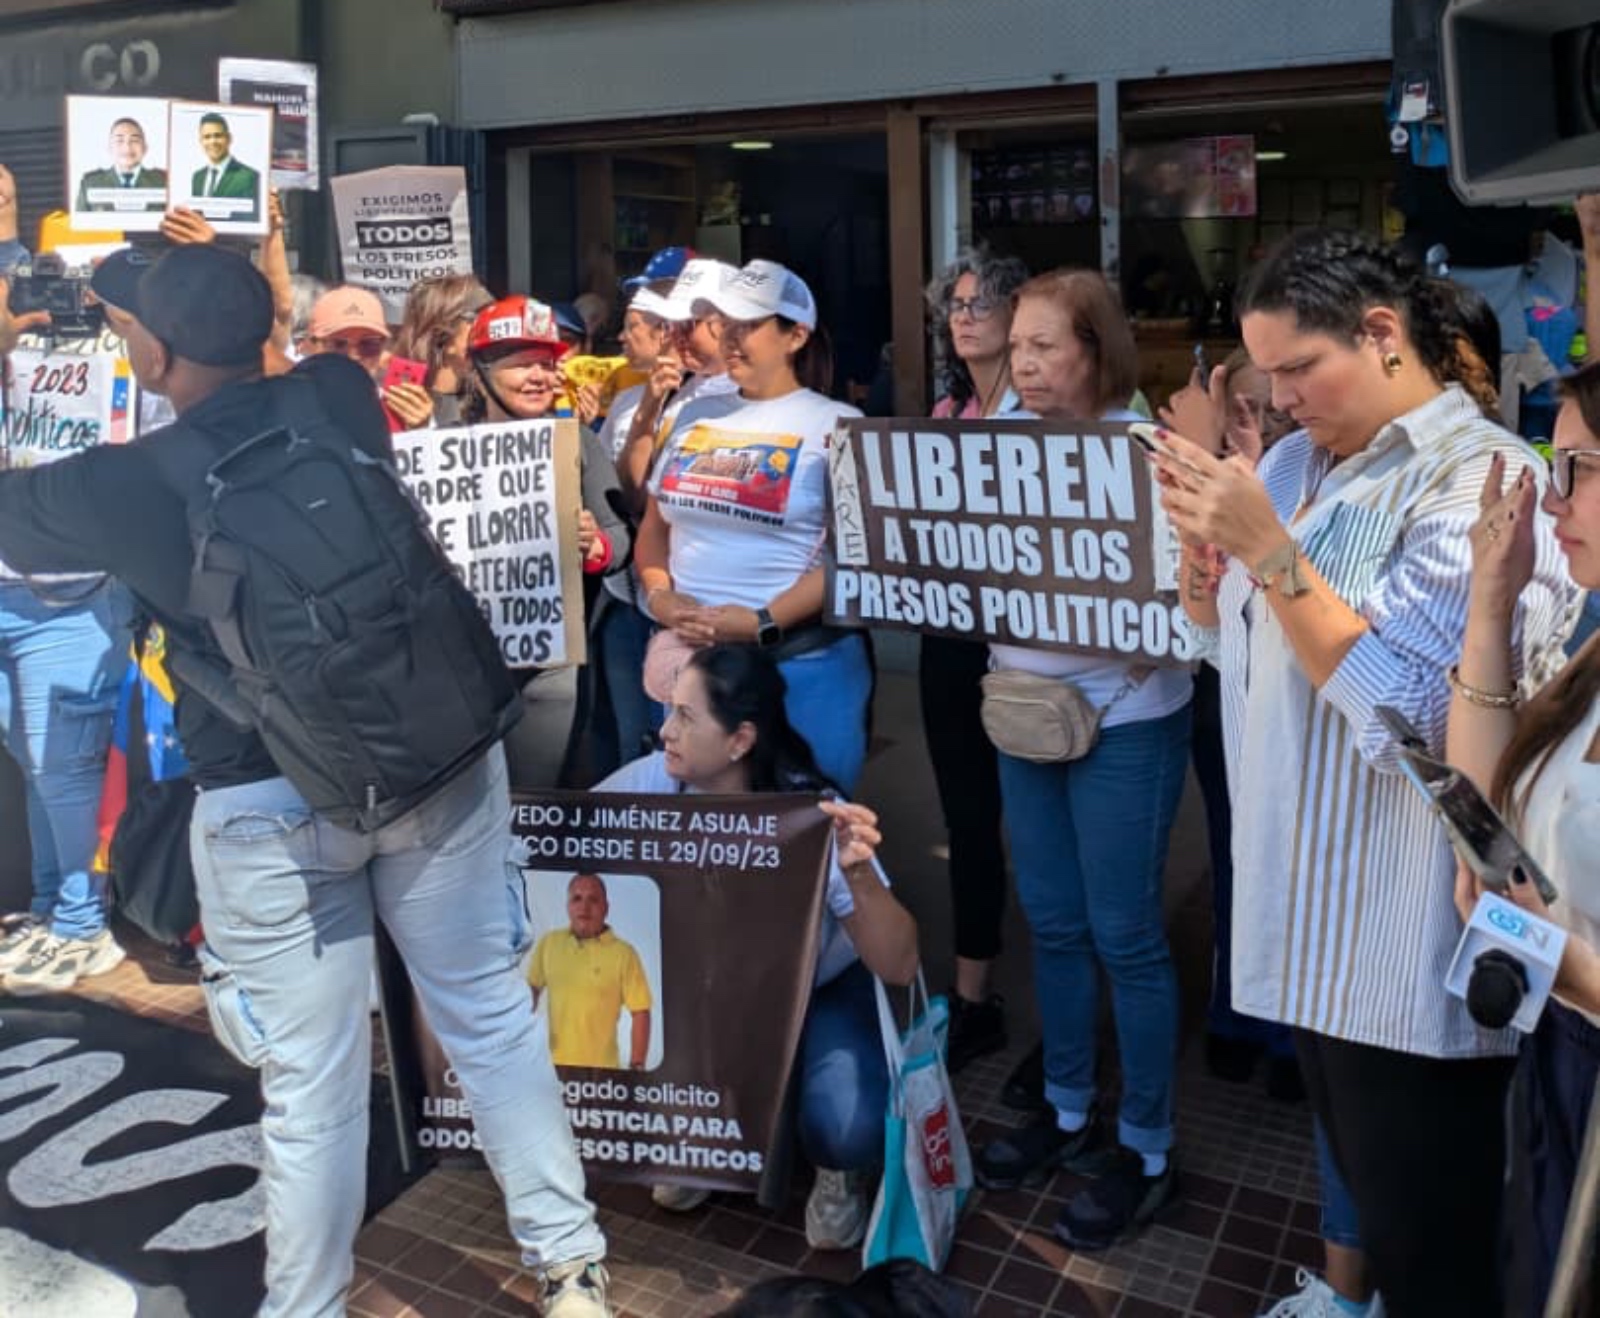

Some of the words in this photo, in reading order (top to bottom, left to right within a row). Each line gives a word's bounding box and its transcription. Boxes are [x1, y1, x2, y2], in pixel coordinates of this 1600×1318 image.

[361, 193, 443, 206] EXIGIMOS
[359, 223, 450, 245] TODOS
[356, 251, 388, 264] LOS
[393, 248, 457, 263] PRESOS
[30, 362, 90, 396] 2023
[499, 463, 546, 498] QUE
[862, 432, 1136, 520] LIBEREN
[467, 501, 551, 550] LLORAR
[884, 517, 908, 564] A
[909, 519, 1042, 577] TODOS
[1052, 526, 1133, 583] LOS
[499, 595, 563, 626] TODOS
[834, 570, 975, 637] PRESOS
[980, 586, 1191, 663] POLITICOS
[498, 629, 553, 663] COS
[570, 809, 582, 826] J
[588, 804, 683, 831] JIMÉNEZ
[689, 811, 778, 836] ASUAJE
[520, 834, 558, 857] CO
[564, 836, 634, 860] DESDE
[641, 841, 663, 861] EL
[669, 838, 780, 870] 29/09/23
[561, 1080, 628, 1104] gado
[634, 1083, 720, 1108] solicito
[672, 1114, 743, 1140] PARA
[633, 1139, 763, 1172] POLÍTICOS
